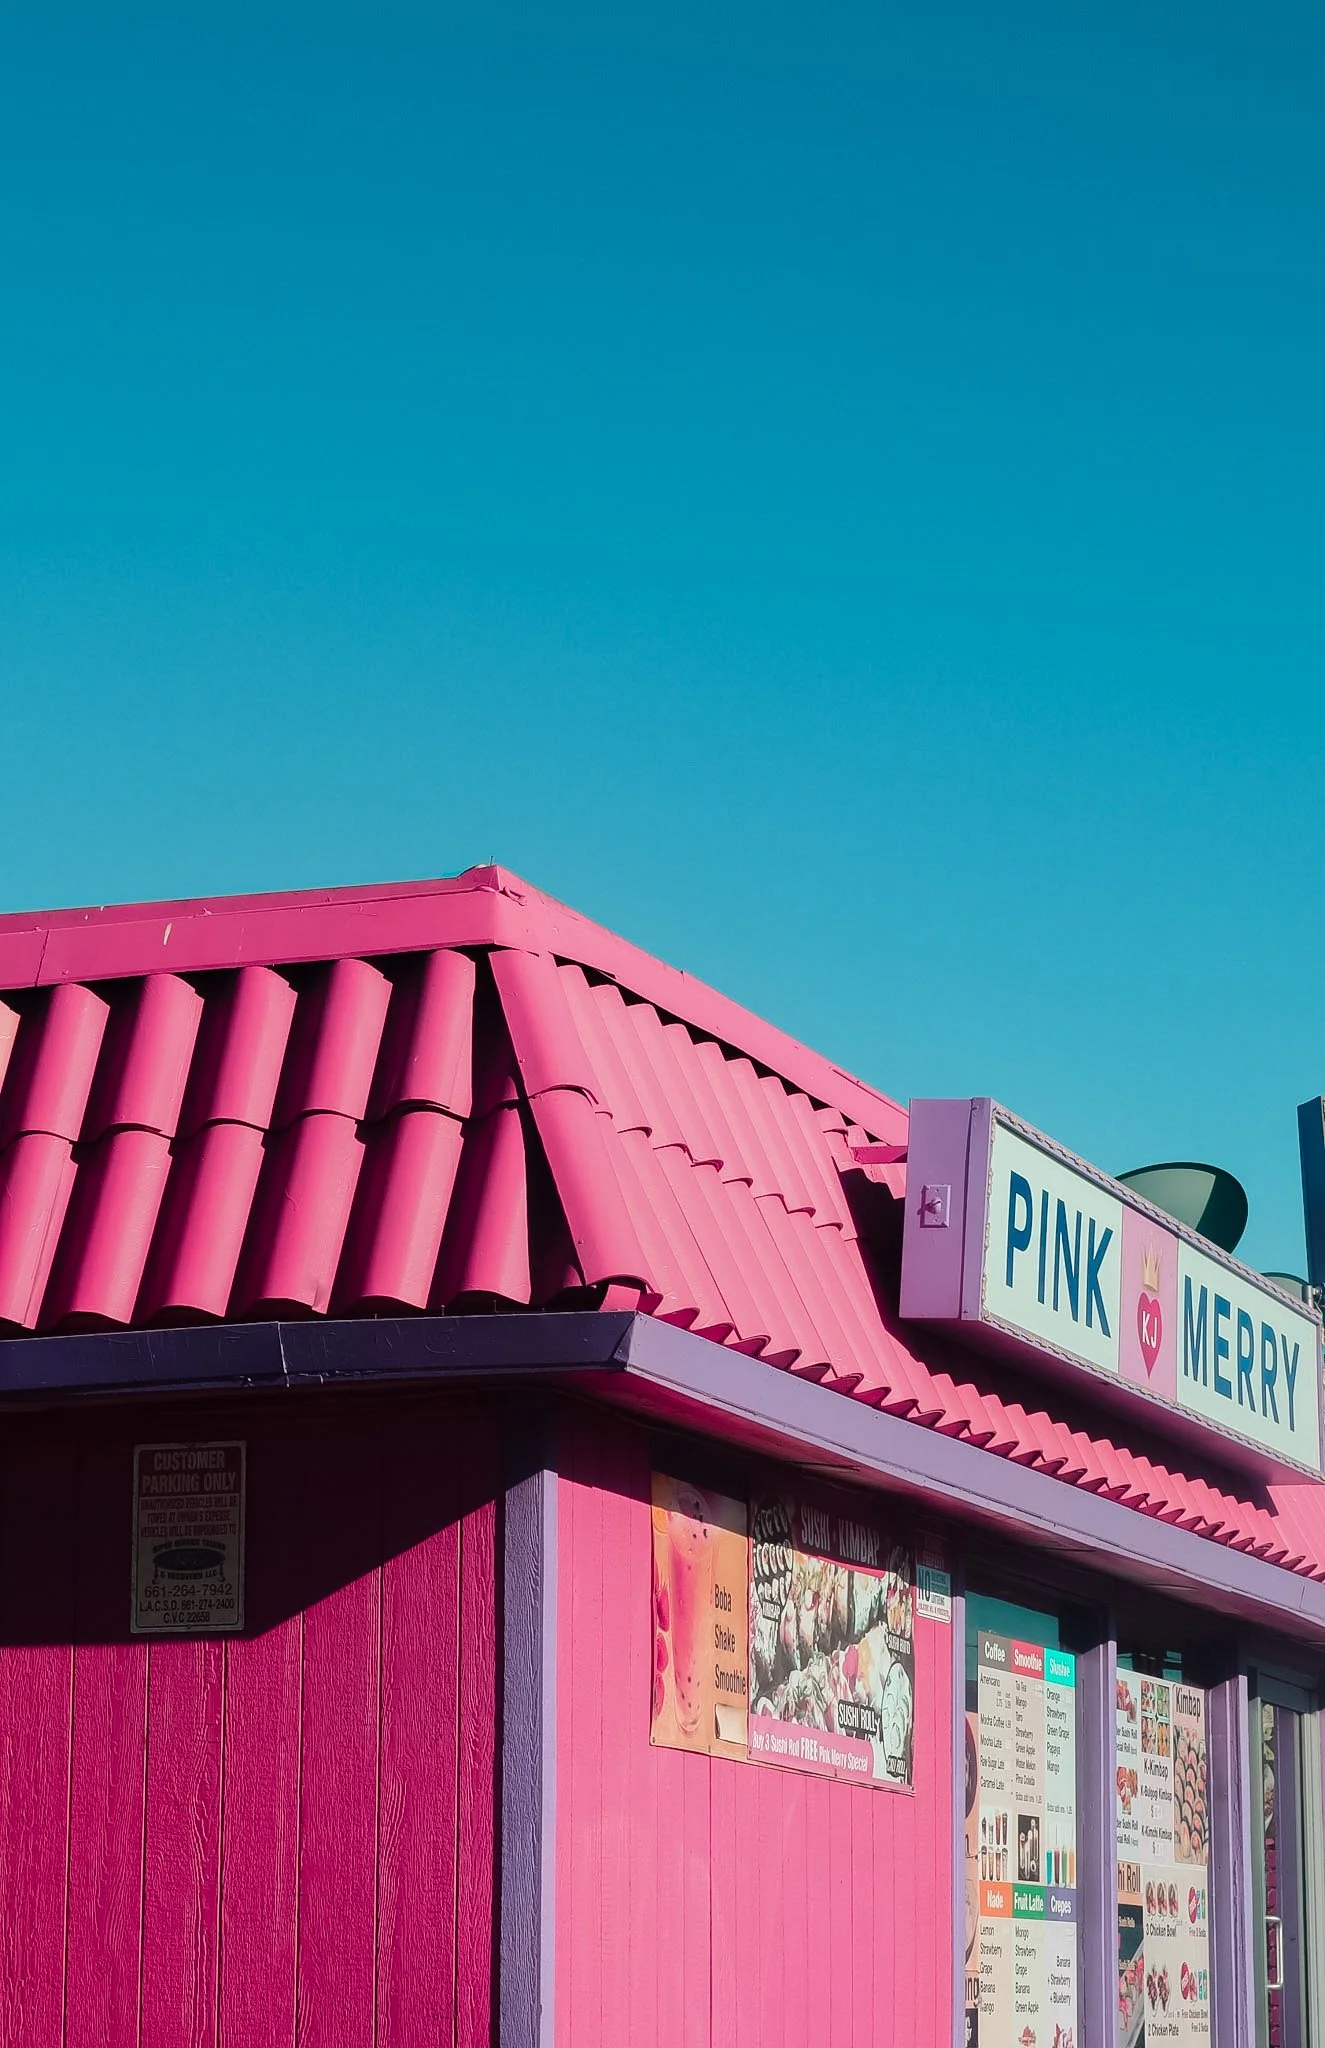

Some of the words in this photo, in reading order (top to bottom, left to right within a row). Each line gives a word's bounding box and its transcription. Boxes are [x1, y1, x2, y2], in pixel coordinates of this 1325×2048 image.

[1005, 1170, 1113, 1339] PINK
[1142, 1315, 1159, 1350] KJ
[1184, 1274, 1300, 1433] MERRY
[154, 1451, 225, 1471] CUSTOMER
[142, 1474, 200, 1494] PARKING
[204, 1472, 236, 1492] ONLY
[801, 1503, 830, 1551] SUSHI
[839, 1518, 880, 1567] KIMBAP
[145, 1584, 232, 1598] 661-264-7942
[919, 1568, 930, 1601] NO
[182, 1599, 234, 1611] 661-274-2400
[714, 1584, 731, 1612] Boba
[187, 1612, 210, 1623] 22658
[714, 1624, 735, 1653] Shake
[985, 1641, 1006, 1662] Coffee
[1015, 1649, 1042, 1672] Smoothie
[1050, 1658, 1070, 1678] Slushie
[714, 1664, 746, 1696] Smoothie
[980, 1673, 1000, 1687] Americano
[1047, 1688, 1060, 1704] Orange
[1176, 1687, 1201, 1723] Kimbap
[839, 1703, 859, 1729] SUSHI
[861, 1709, 876, 1732] ROLL
[1047, 1706, 1067, 1723] Strawberry
[1047, 1724, 1058, 1737] Green
[752, 1732, 764, 1751] Buy
[765, 1734, 770, 1750] 3
[771, 1736, 787, 1754] Sushi
[789, 1739, 800, 1757] Roll
[801, 1738, 818, 1762] FREE
[820, 1746, 830, 1763] Pink
[831, 1748, 847, 1769] Merry
[848, 1753, 868, 1772] Special
[1047, 1742, 1061, 1757] Papaya
[1047, 1760, 1060, 1775] Mango
[1144, 1758, 1168, 1781] K-Kimbap
[1159, 1787, 1172, 1804] Kimbap
[1159, 1827, 1172, 1841] Kimbap
[1127, 1865, 1141, 1892] Roll
[1014, 1893, 1028, 1911] Fruit
[1029, 1895, 1044, 1912] Latte
[1050, 1896, 1072, 1917] Crepes
[980, 1926, 994, 1937] Lemon
[1146, 1925, 1149, 1936] 3
[1150, 1926, 1166, 1936] Chicken
[1167, 1926, 1177, 1937] Bowl
[980, 1943, 1002, 1958] Strawberry
[1015, 1945, 1036, 1959] Strawberry
[980, 1963, 992, 1974] Grape
[1015, 1964, 1027, 1976] Grape
[1056, 1956, 1070, 1968] Banana
[980, 1981, 996, 1994] Banana
[1015, 1983, 1030, 1995] Banana
[1051, 1975, 1071, 1988] Strawberry
[1053, 1992, 1071, 2006] Blueberry
[1015, 2002, 1027, 2013] Green
[1028, 2002, 1039, 2015] Apple
[1152, 2024, 1168, 2036] Chicken
[1169, 2024, 1179, 2036] Plate
